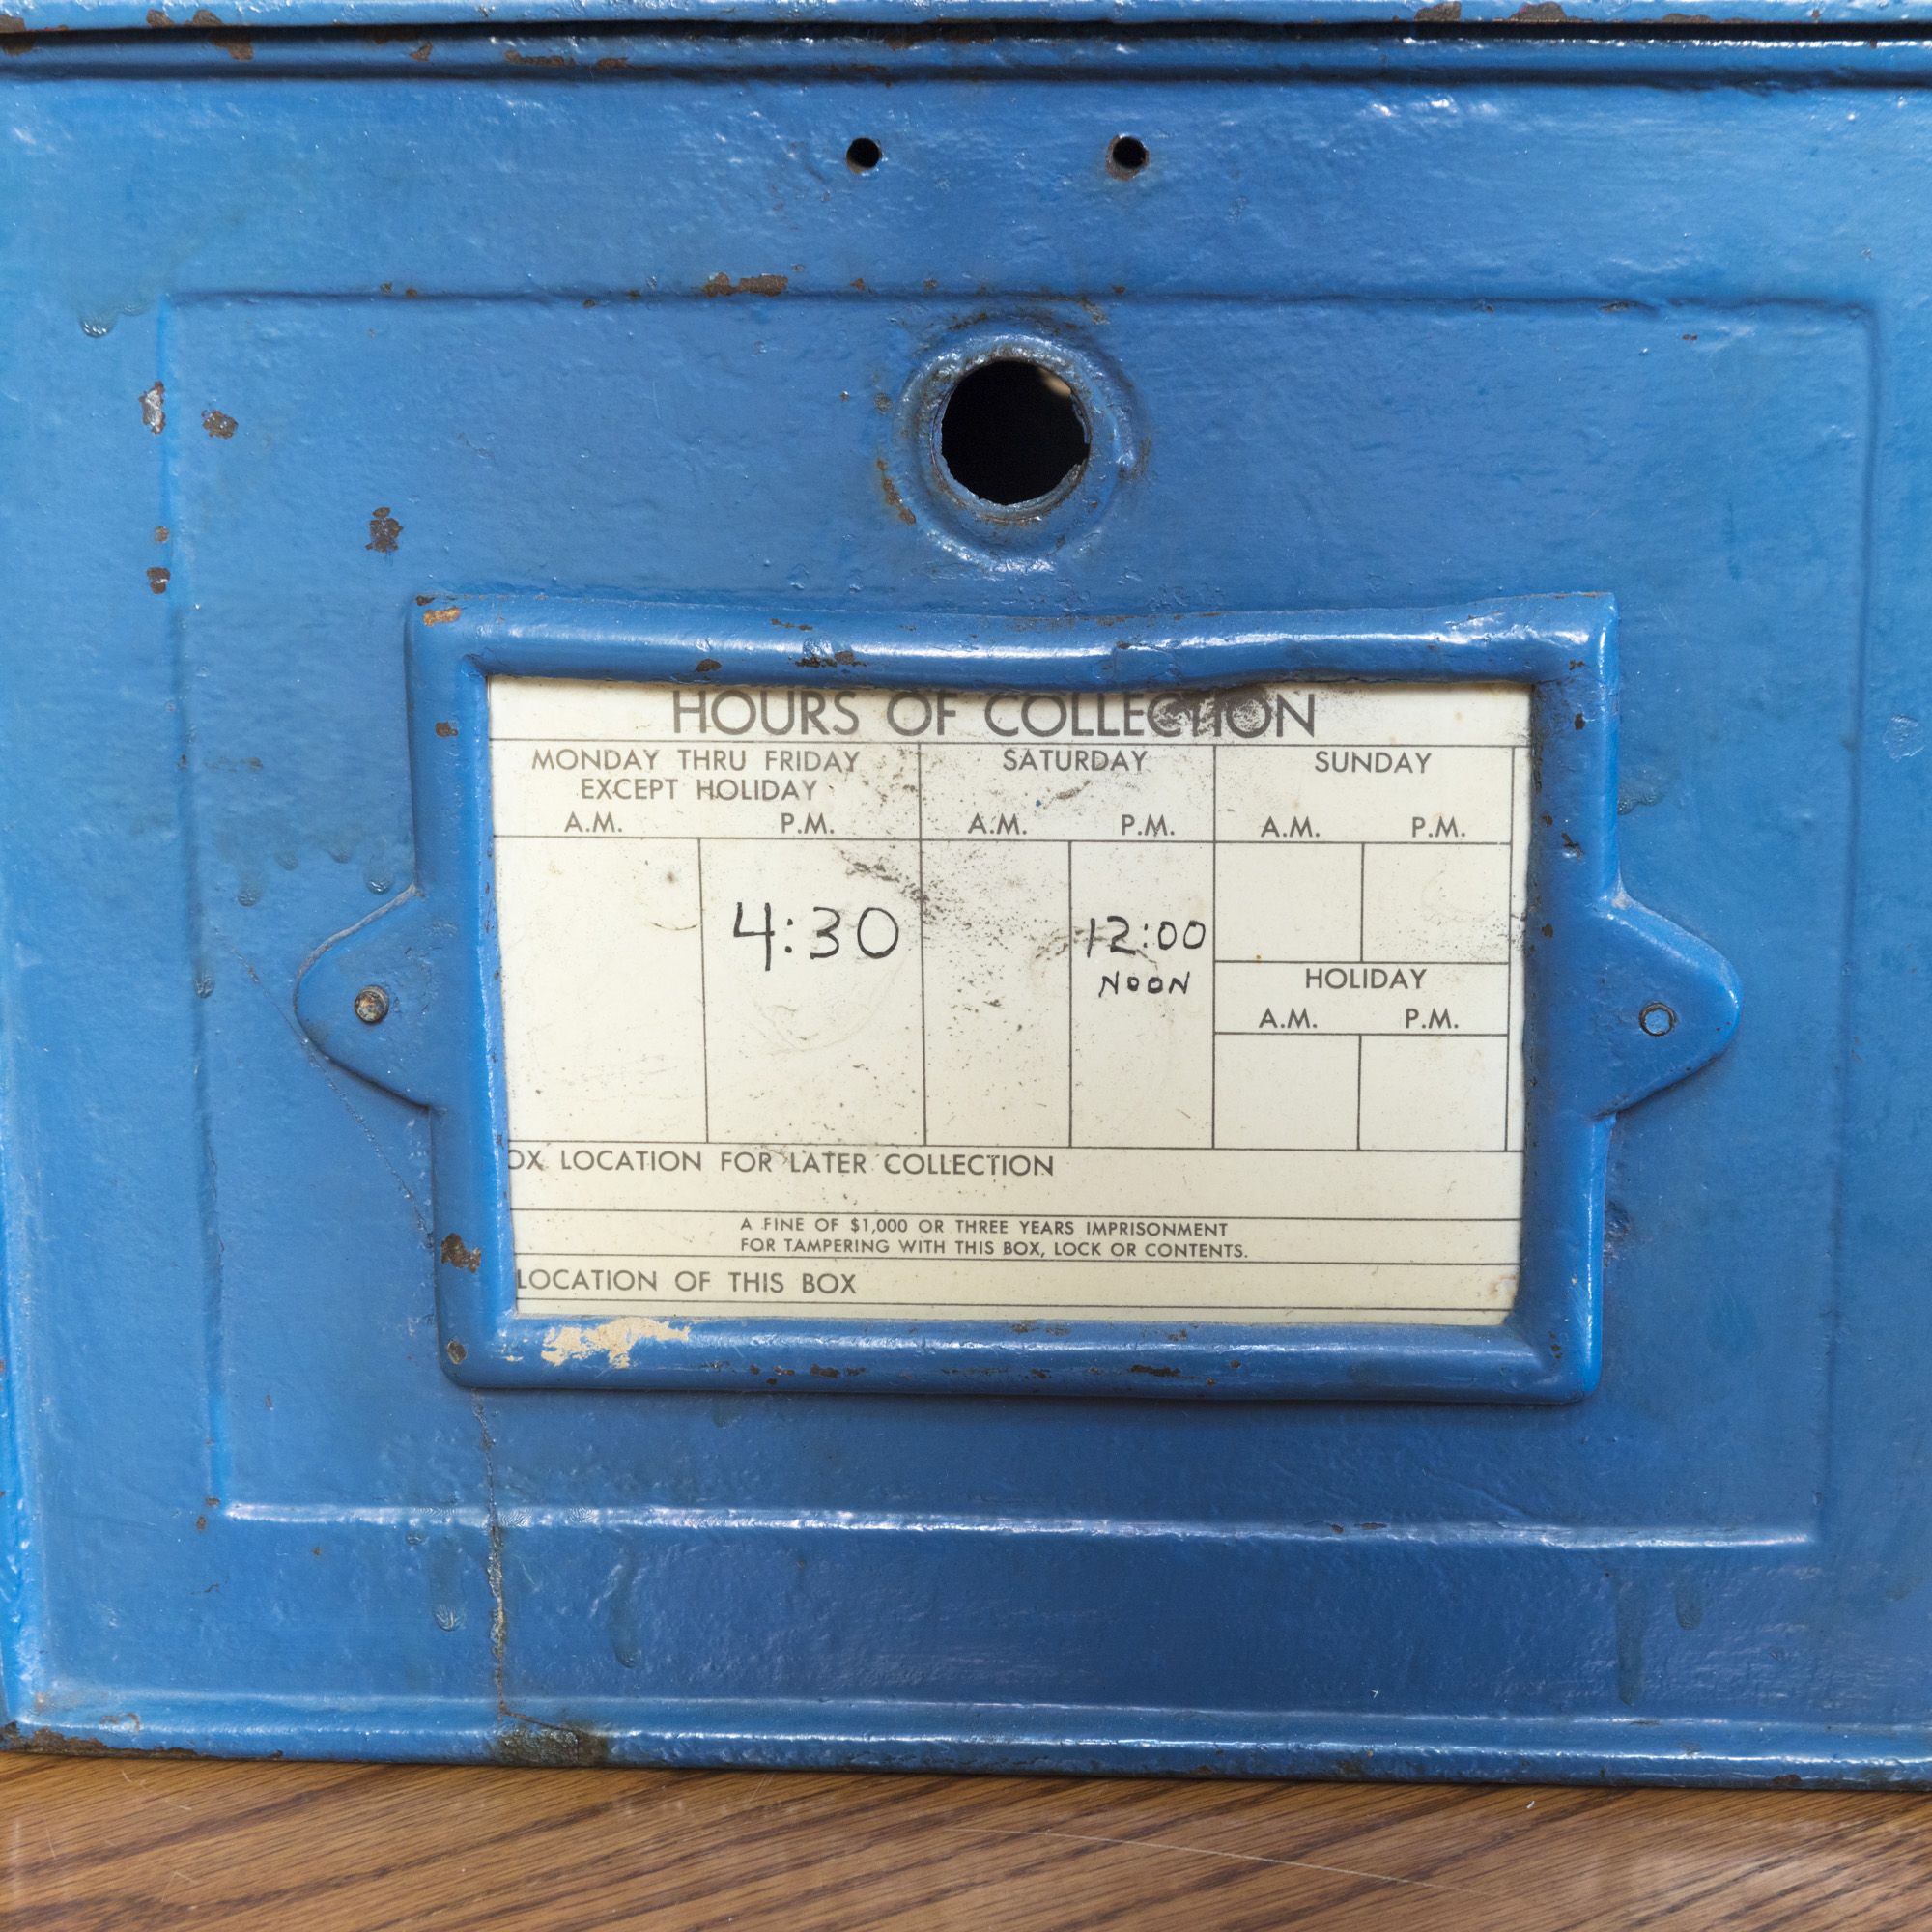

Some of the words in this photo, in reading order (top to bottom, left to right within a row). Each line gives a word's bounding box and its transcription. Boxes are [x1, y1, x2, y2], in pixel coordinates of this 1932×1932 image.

[673, 690, 859, 736] HOURS
[887, 690, 956, 736] OF
[984, 693, 1315, 738] COLLECTION
[531, 749, 659, 770] MONDAY
[678, 750, 747, 771] THRU
[766, 750, 861, 773] FRIDAY
[1002, 749, 1148, 772] SATURDAY
[1314, 751, 1432, 774] SUNDAY
[582, 778, 678, 800] EXCEPT
[696, 779, 819, 801] HOLIDAY
[564, 811, 623, 833] A.M.
[781, 812, 835, 834] P.M.
[969, 812, 1028, 835] A.M.
[1122, 814, 1176, 837] P.M.
[1261, 816, 1321, 838] A.M.
[1412, 816, 1466, 838] P.M.
[733, 901, 899, 972] 4:30
[1087, 916, 1207, 958] 12:00
[1097, 972, 1191, 998] NOON
[1305, 967, 1427, 990] HOLIDAY
[1259, 1008, 1318, 1030] A.M.
[1406, 1008, 1459, 1030] P.M.
[561, 1150, 701, 1171] LOCATION
[721, 1151, 772, 1173] FOR
[790, 1152, 867, 1174] LATER
[884, 1153, 1054, 1177] COLLECTION
[740, 1218, 752, 1231] A
[764, 1217, 805, 1231] FINE
[814, 1218, 838, 1232] OF
[850, 1218, 908, 1235] $1,000
[918, 1219, 944, 1233] OR
[956, 1220, 1009, 1234] THREE
[1019, 1221, 1074, 1236] YEARS
[1087, 1222, 1229, 1237] IMPRISONMENT
[741, 1238, 776, 1252] FOR
[784, 1239, 890, 1254] TAMPERING
[898, 1240, 946, 1254] WITH
[955, 1240, 994, 1255] THIS
[1003, 1241, 1045, 1258] BOX,
[1054, 1242, 1101, 1257] LOCK
[1111, 1243, 1137, 1257] OR
[1145, 1244, 1248, 1259] CONTENTS.
[517, 1269, 657, 1291] LOCATION
[675, 1271, 711, 1293] OF
[728, 1272, 784, 1293] THIS
[802, 1273, 857, 1295] BOX
